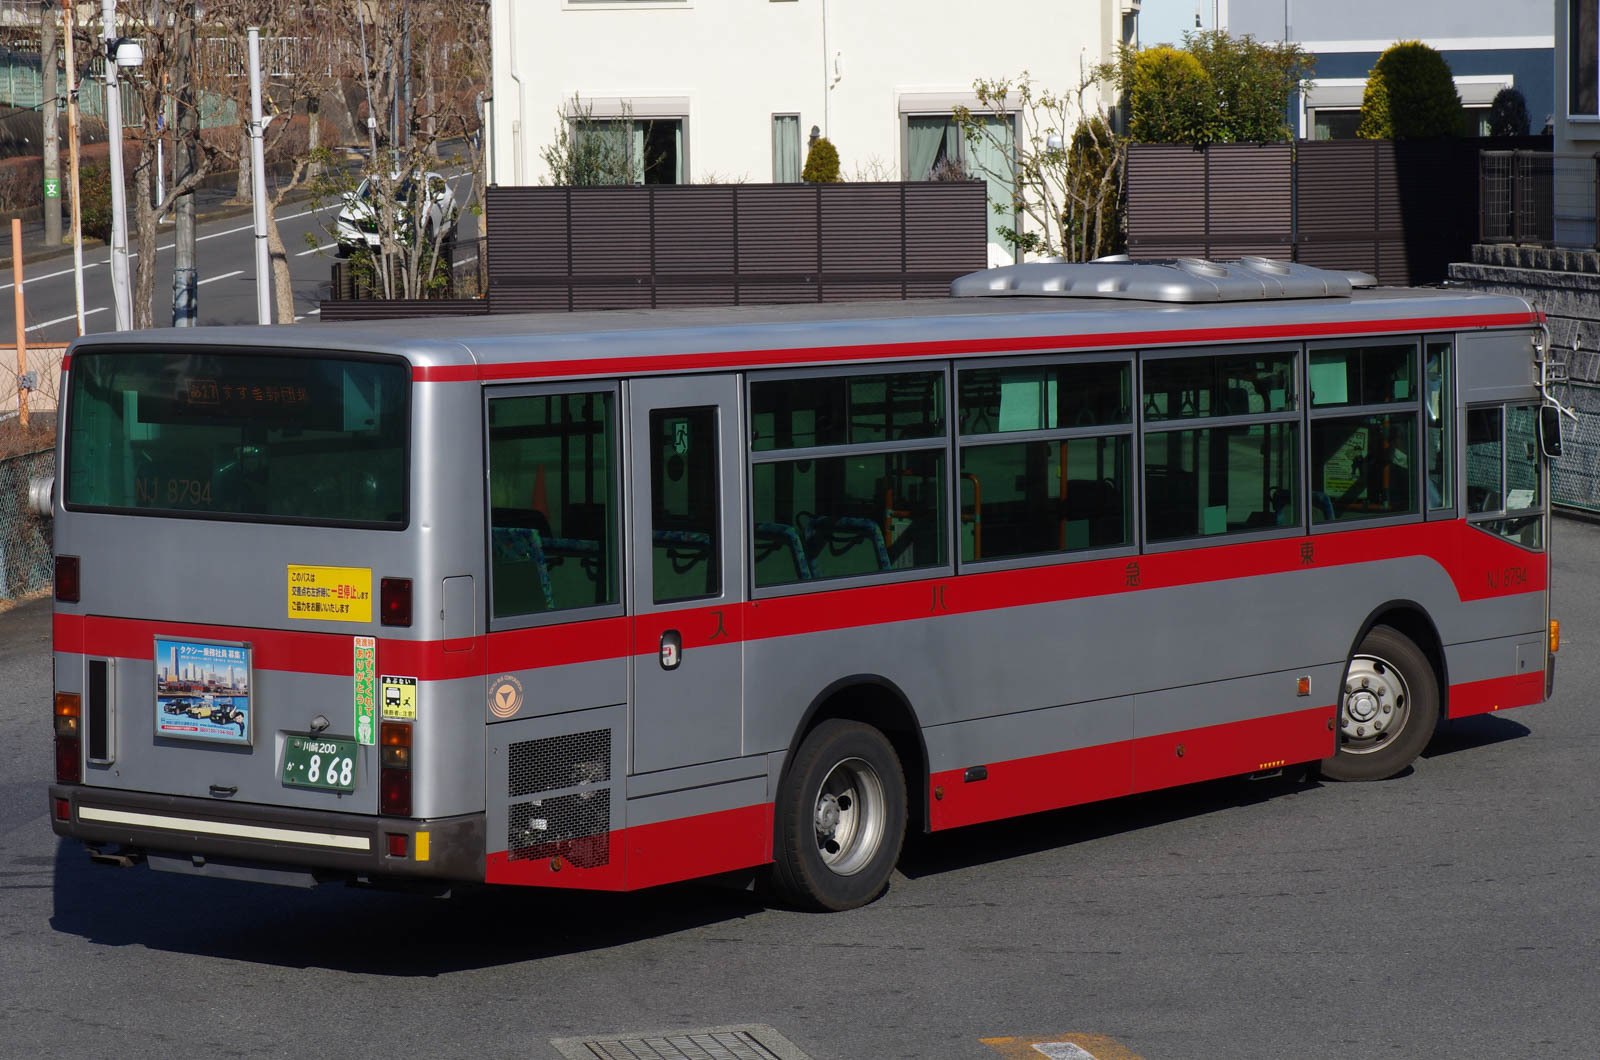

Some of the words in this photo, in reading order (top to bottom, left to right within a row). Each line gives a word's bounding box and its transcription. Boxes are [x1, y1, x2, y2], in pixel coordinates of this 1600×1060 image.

[135, 478, 159, 504] NJ
[167, 479, 213, 505] 8794
[1300, 542, 1314, 565] 東
[291, 572, 316, 583] このバスは
[1126, 562, 1141, 586] 急
[1487, 570, 1499, 588] NJ
[1504, 567, 1527, 587] 8794
[291, 601, 350, 614] ご協力をお願いいたします
[365, 649, 374, 716] ゆずってくれて
[385, 677, 411, 685] あぶない
